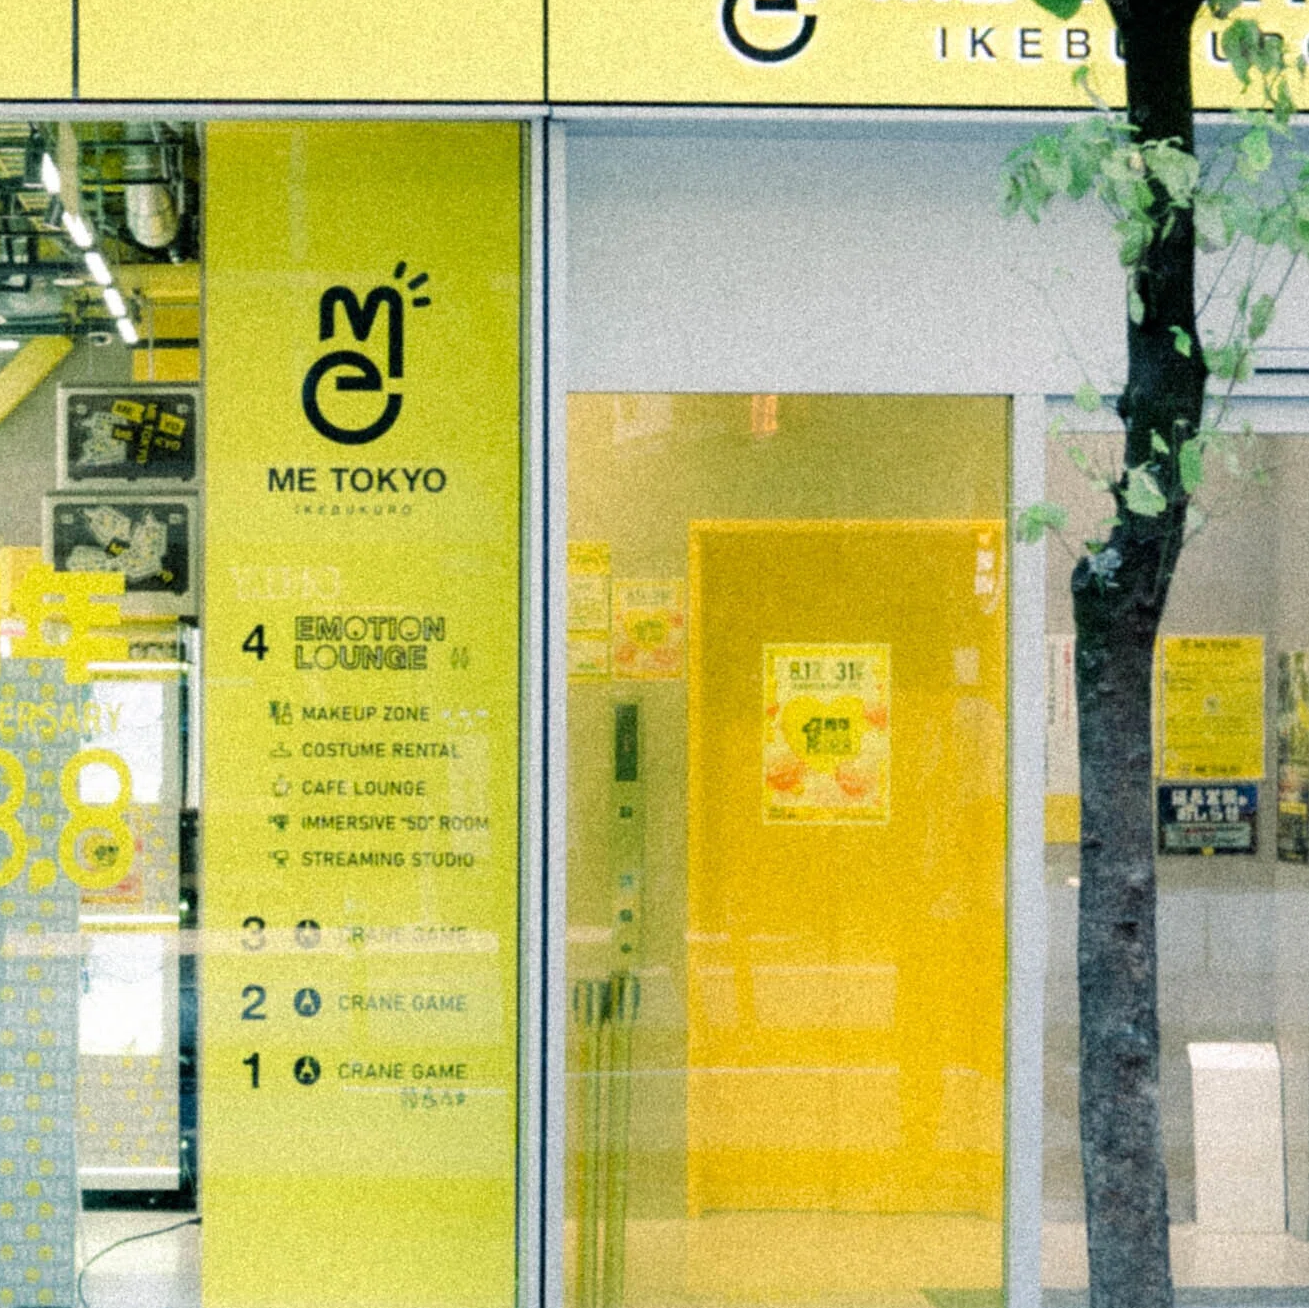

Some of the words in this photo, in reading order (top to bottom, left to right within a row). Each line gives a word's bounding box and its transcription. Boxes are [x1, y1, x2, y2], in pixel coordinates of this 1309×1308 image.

[267, 467, 317, 492] ME
[330, 467, 447, 493] TOKYO
[242, 624, 269, 660] 4
[294, 615, 446, 641] EMOTION
[294, 644, 428, 670] LOUNGE
[301, 706, 377, 722] MAKEUP
[383, 706, 430, 722] ZONE
[301, 743, 386, 758] COSTUME
[392, 743, 461, 758] RENTAL
[301, 781, 348, 796] CAFE
[353, 781, 427, 796] LOUNGE
[301, 815, 394, 831] IMMERSIVE
[439, 815, 489, 831] ROOM
[301, 852, 405, 867] STREAMING
[411, 852, 475, 867] STUDIO
[242, 916, 266, 951] 3
[242, 984, 266, 1020] 2
[338, 995, 404, 1011] CRANE
[412, 995, 468, 1011] GAME
[243, 1052, 260, 1088] 1
[338, 1064, 403, 1080] CRANE
[412, 1064, 468, 1080] GAME
